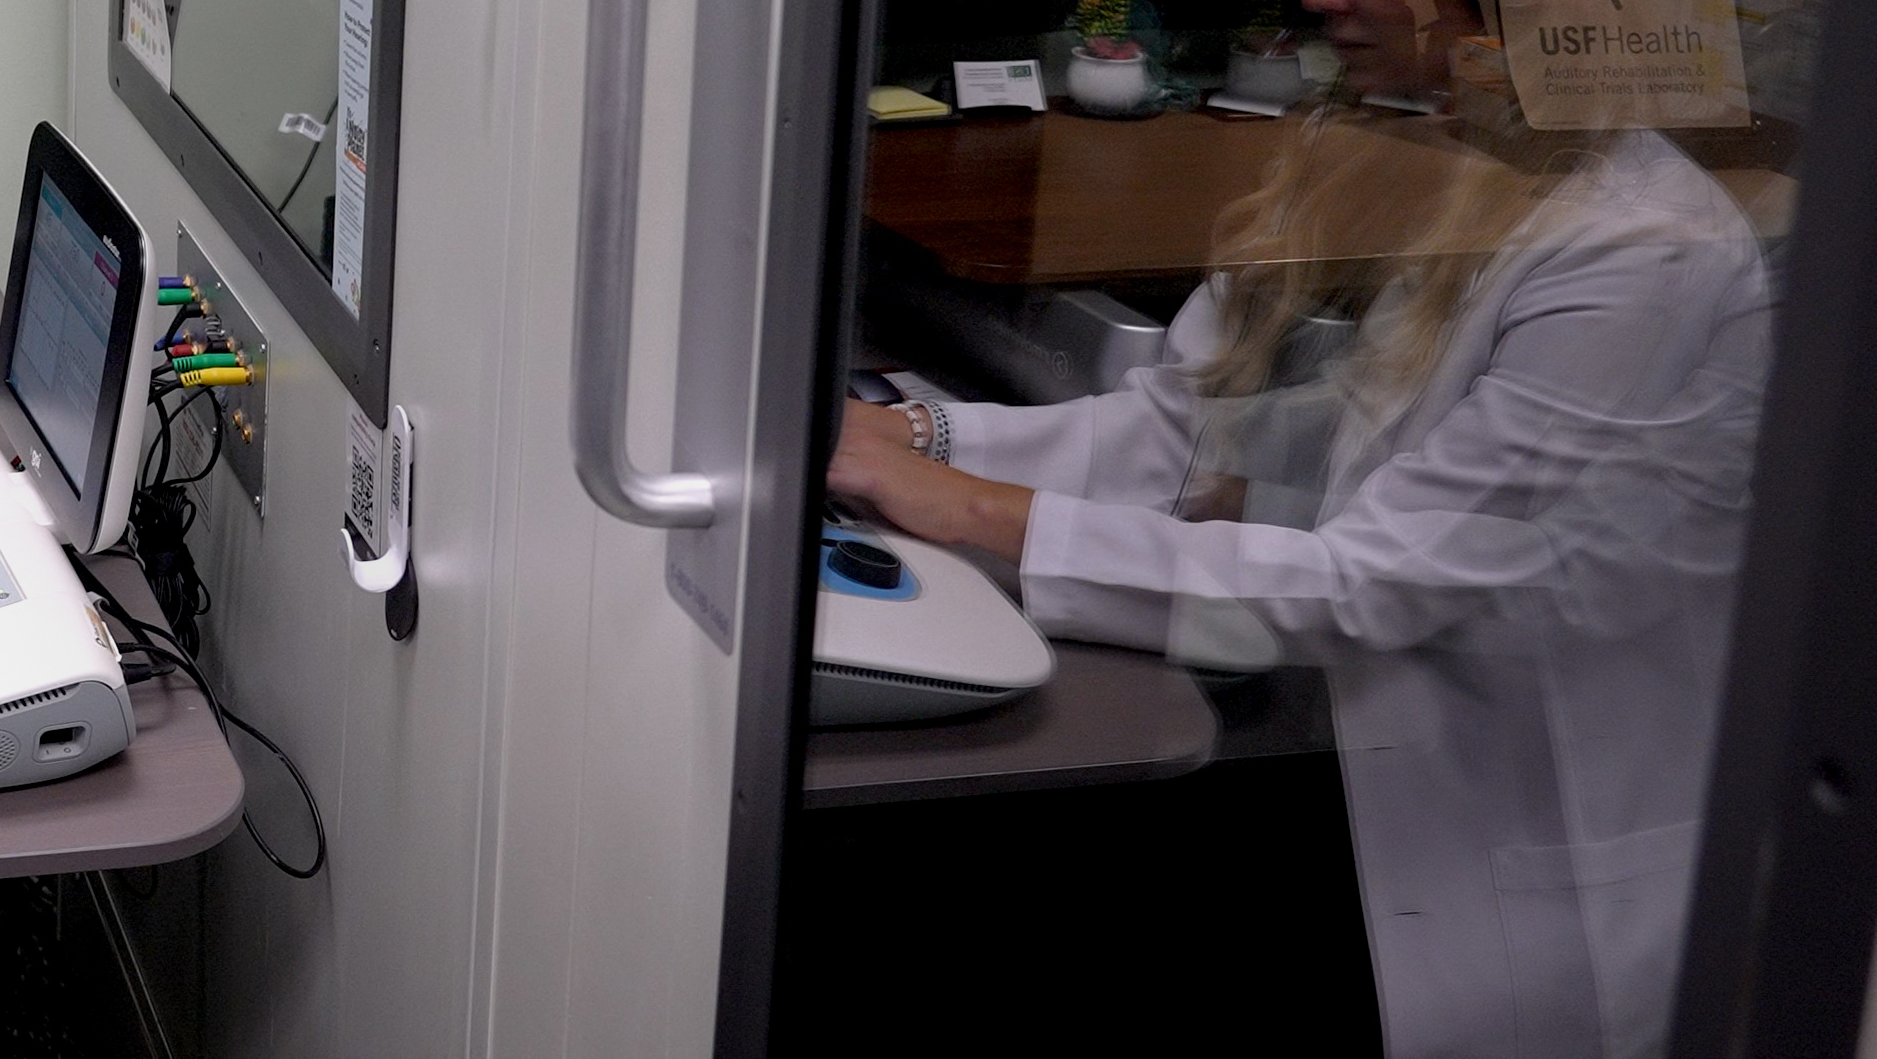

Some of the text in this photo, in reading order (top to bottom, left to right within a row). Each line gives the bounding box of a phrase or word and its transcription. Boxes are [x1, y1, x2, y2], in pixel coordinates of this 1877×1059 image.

[1544, 65, 1706, 81] Auditory Rehabilitation &
[1545, 82, 1706, 95] Clinical Trials Laboratory
